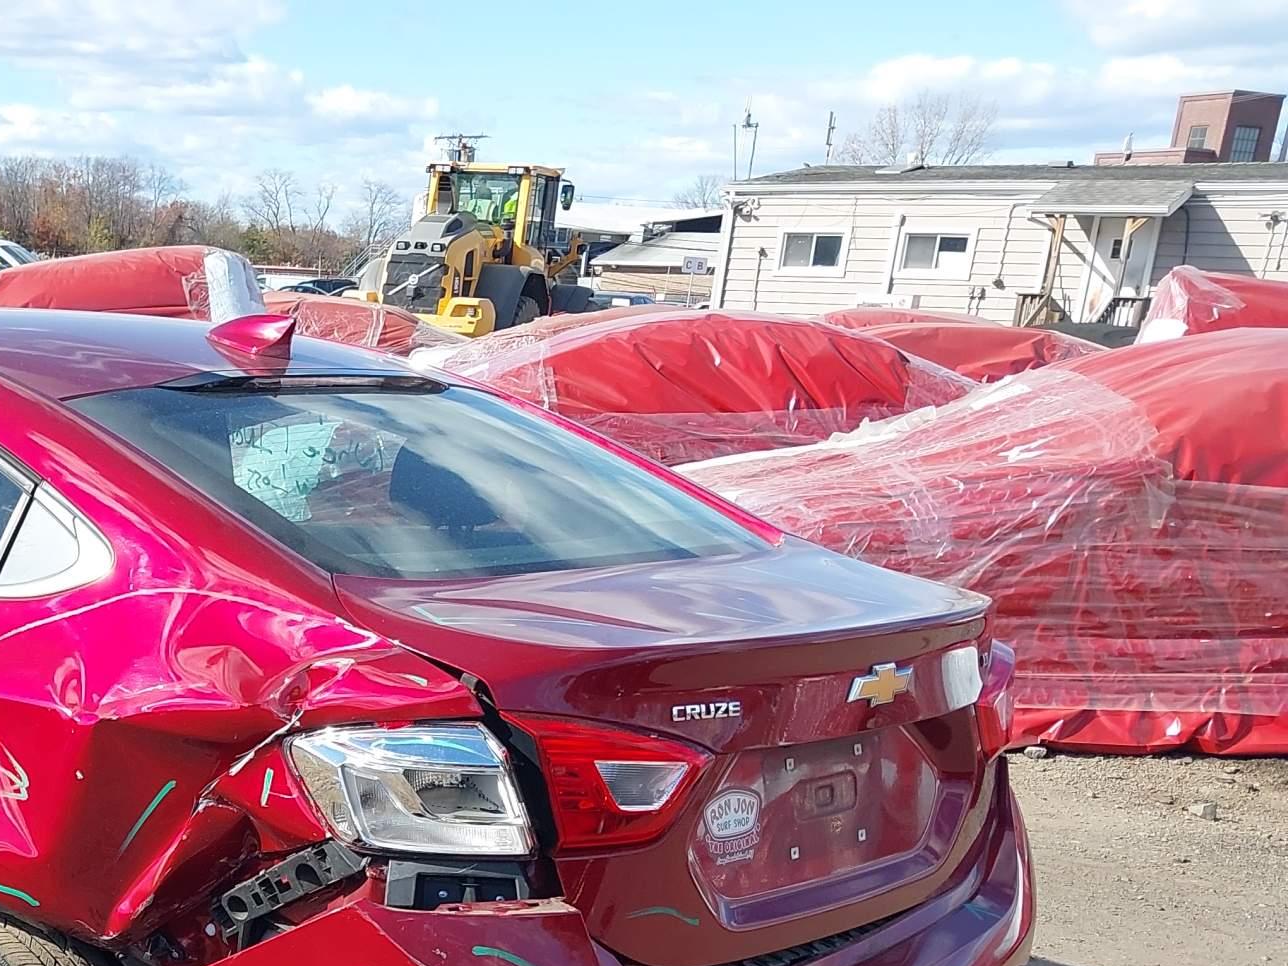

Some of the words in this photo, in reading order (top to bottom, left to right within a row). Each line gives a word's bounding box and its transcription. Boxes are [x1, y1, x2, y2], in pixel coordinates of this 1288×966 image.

[686, 260, 692, 270] C
[697, 261, 703, 270] B
[672, 701, 741, 722] CRUZE
[710, 799, 732, 825] RON
[734, 798, 755, 816] JON
[716, 820, 731, 832] SURF
[733, 817, 750, 828] SHOP
